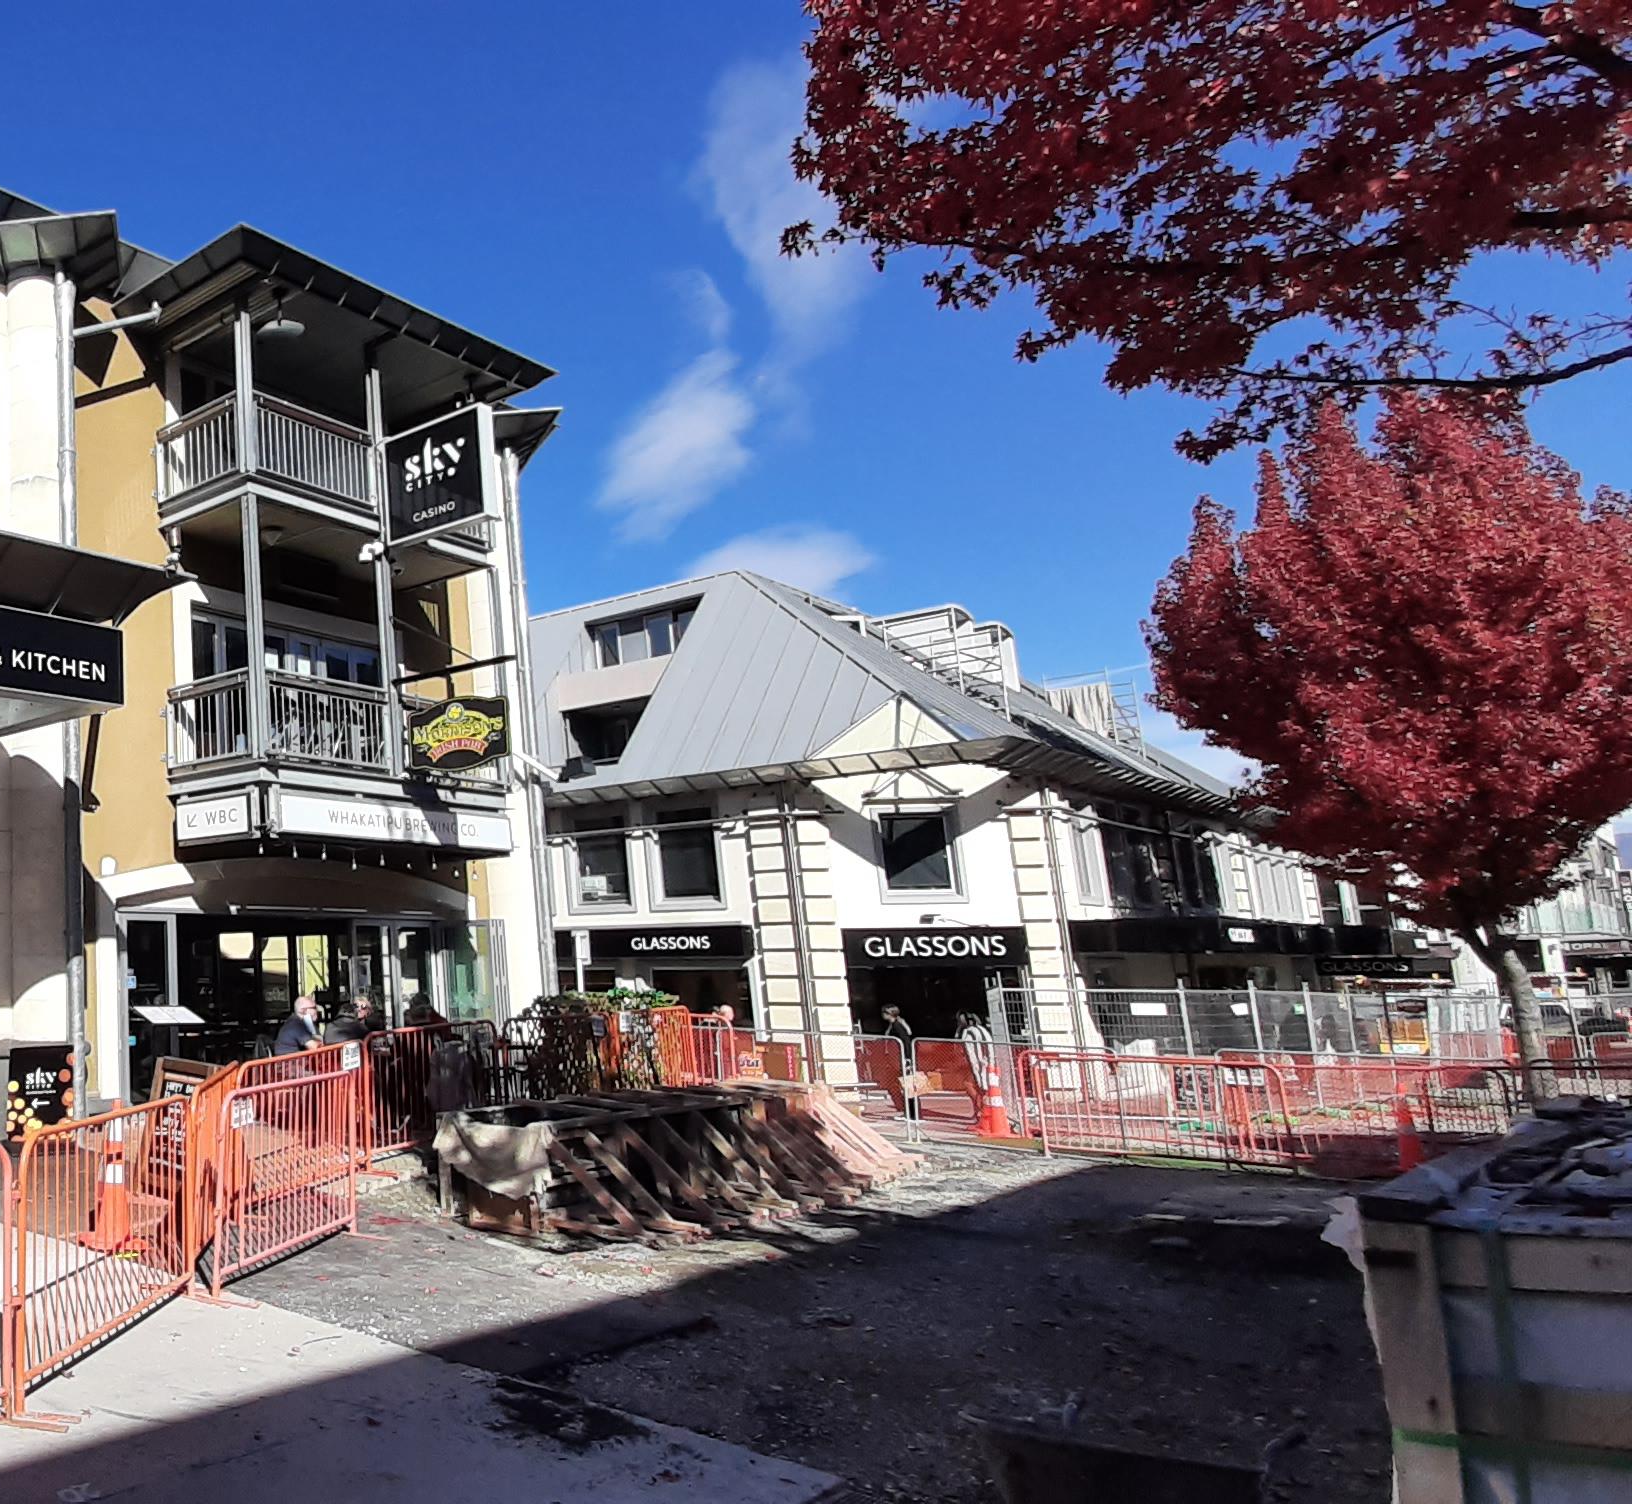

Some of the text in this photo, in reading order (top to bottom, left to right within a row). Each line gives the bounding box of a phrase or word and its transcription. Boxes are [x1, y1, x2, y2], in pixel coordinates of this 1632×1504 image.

[406, 472, 444, 492] CITY
[413, 501, 456, 522] CASINO
[12, 649, 106, 682] KITCHEN
[205, 809, 239, 825] WBC
[327, 809, 402, 831] WHAKATIPU
[404, 817, 458, 835] BREWING
[630, 935, 711, 951] GLASSONS
[864, 935, 1007, 958] GLASSONS
[1320, 961, 1409, 973] GLASSONS
